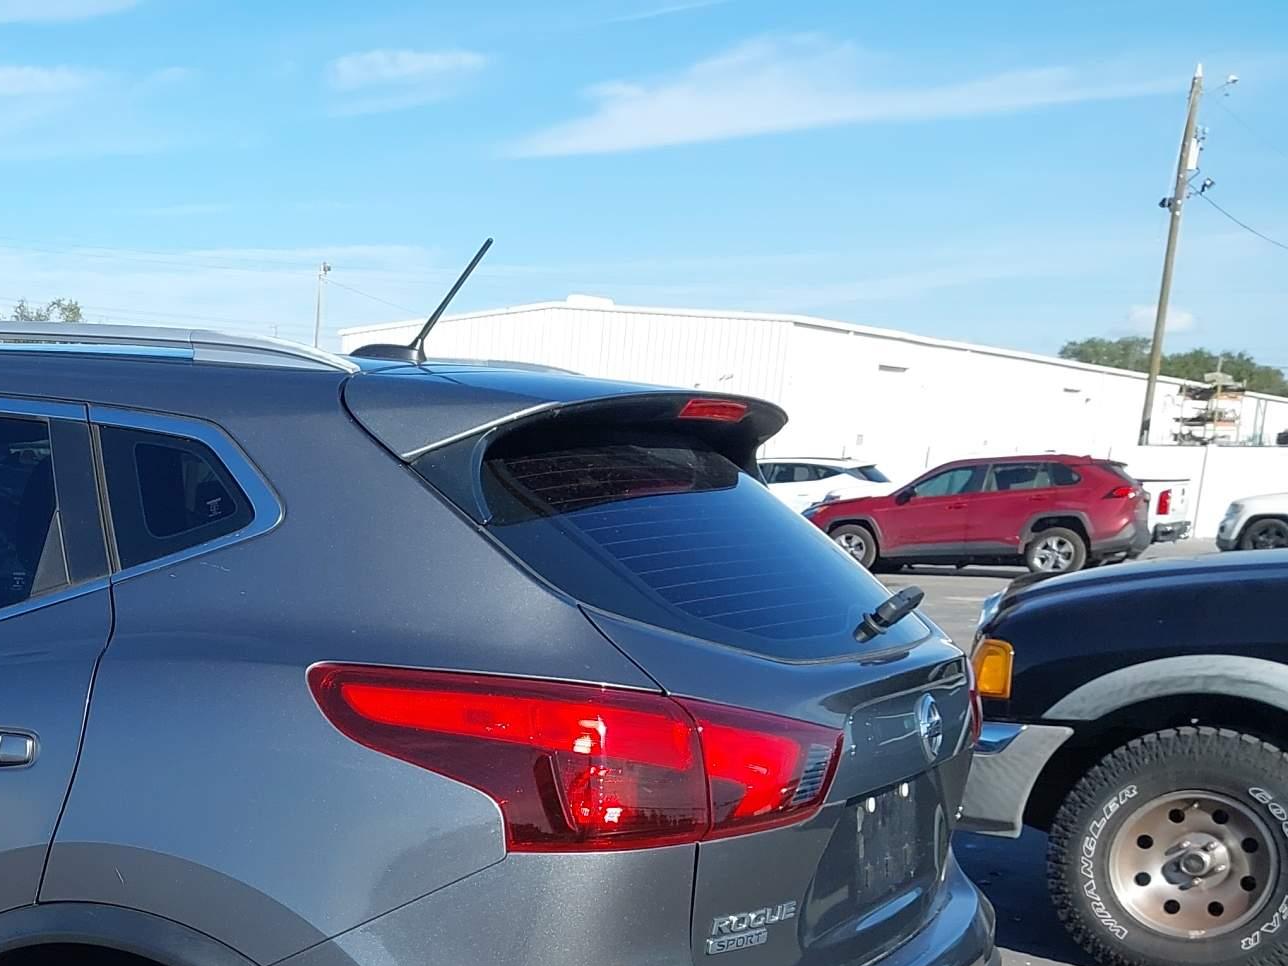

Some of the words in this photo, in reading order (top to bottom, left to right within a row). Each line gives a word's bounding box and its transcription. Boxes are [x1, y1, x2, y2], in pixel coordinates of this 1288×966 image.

[1081, 785, 1138, 940] WRANGLER
[712, 901, 797, 936] ROGUE
[716, 931, 764, 952] SPORT
